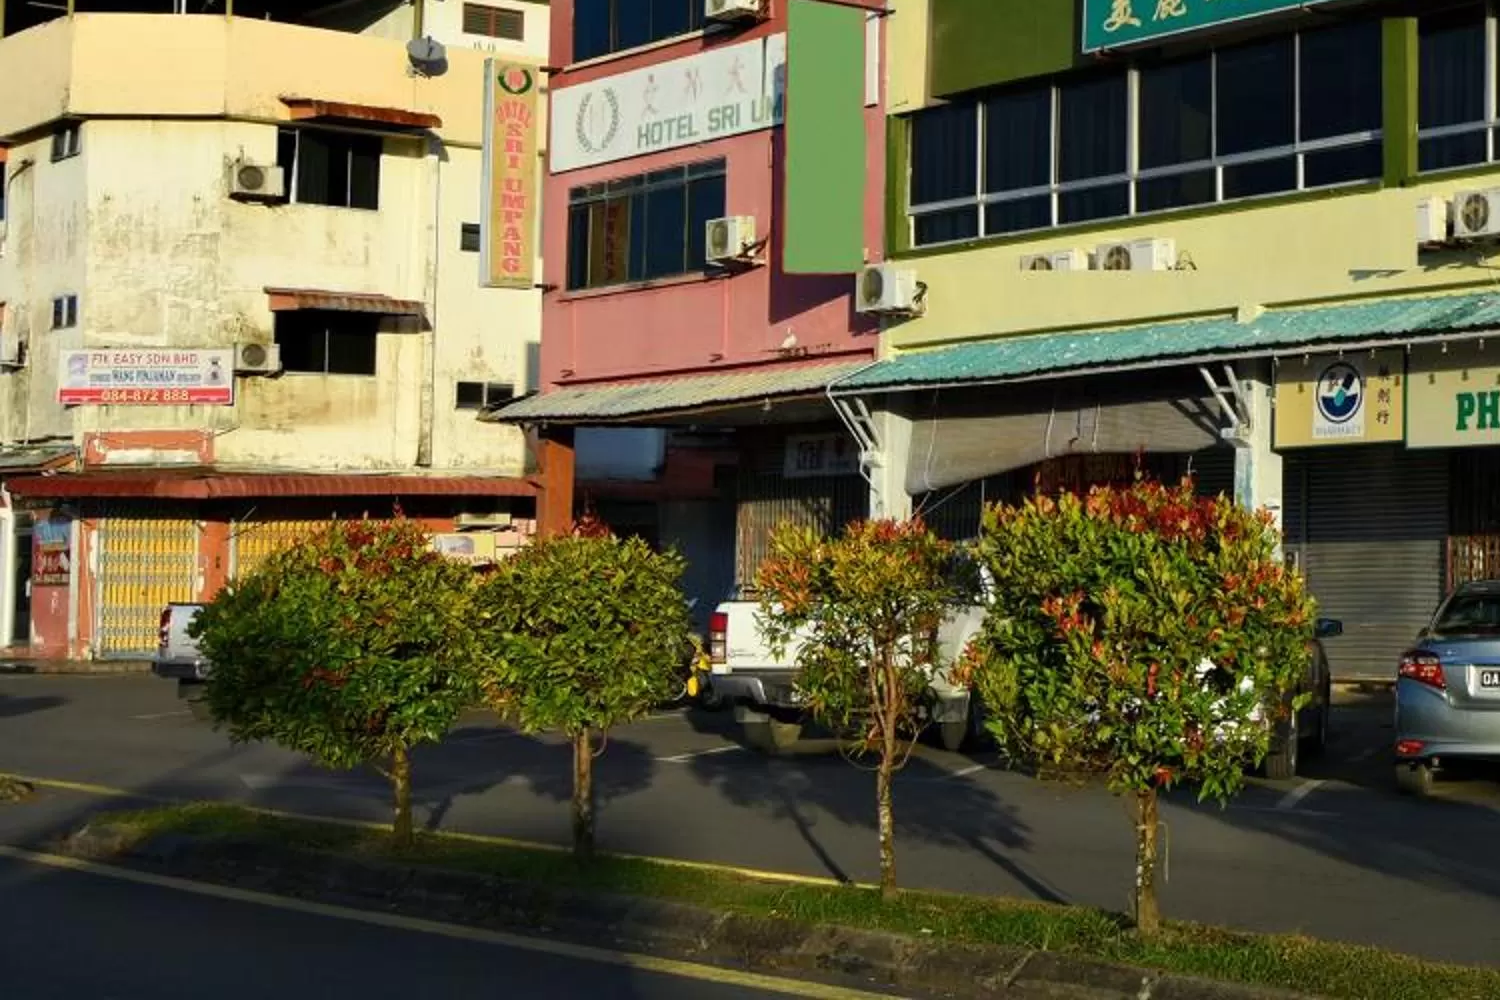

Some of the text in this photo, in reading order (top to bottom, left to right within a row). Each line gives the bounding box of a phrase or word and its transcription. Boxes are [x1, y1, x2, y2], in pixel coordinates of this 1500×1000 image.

[636, 111, 701, 149] HOTEL
[707, 103, 741, 133] SRI
[501, 178, 525, 273] UMPANG
[113, 353, 142, 364] EASY
